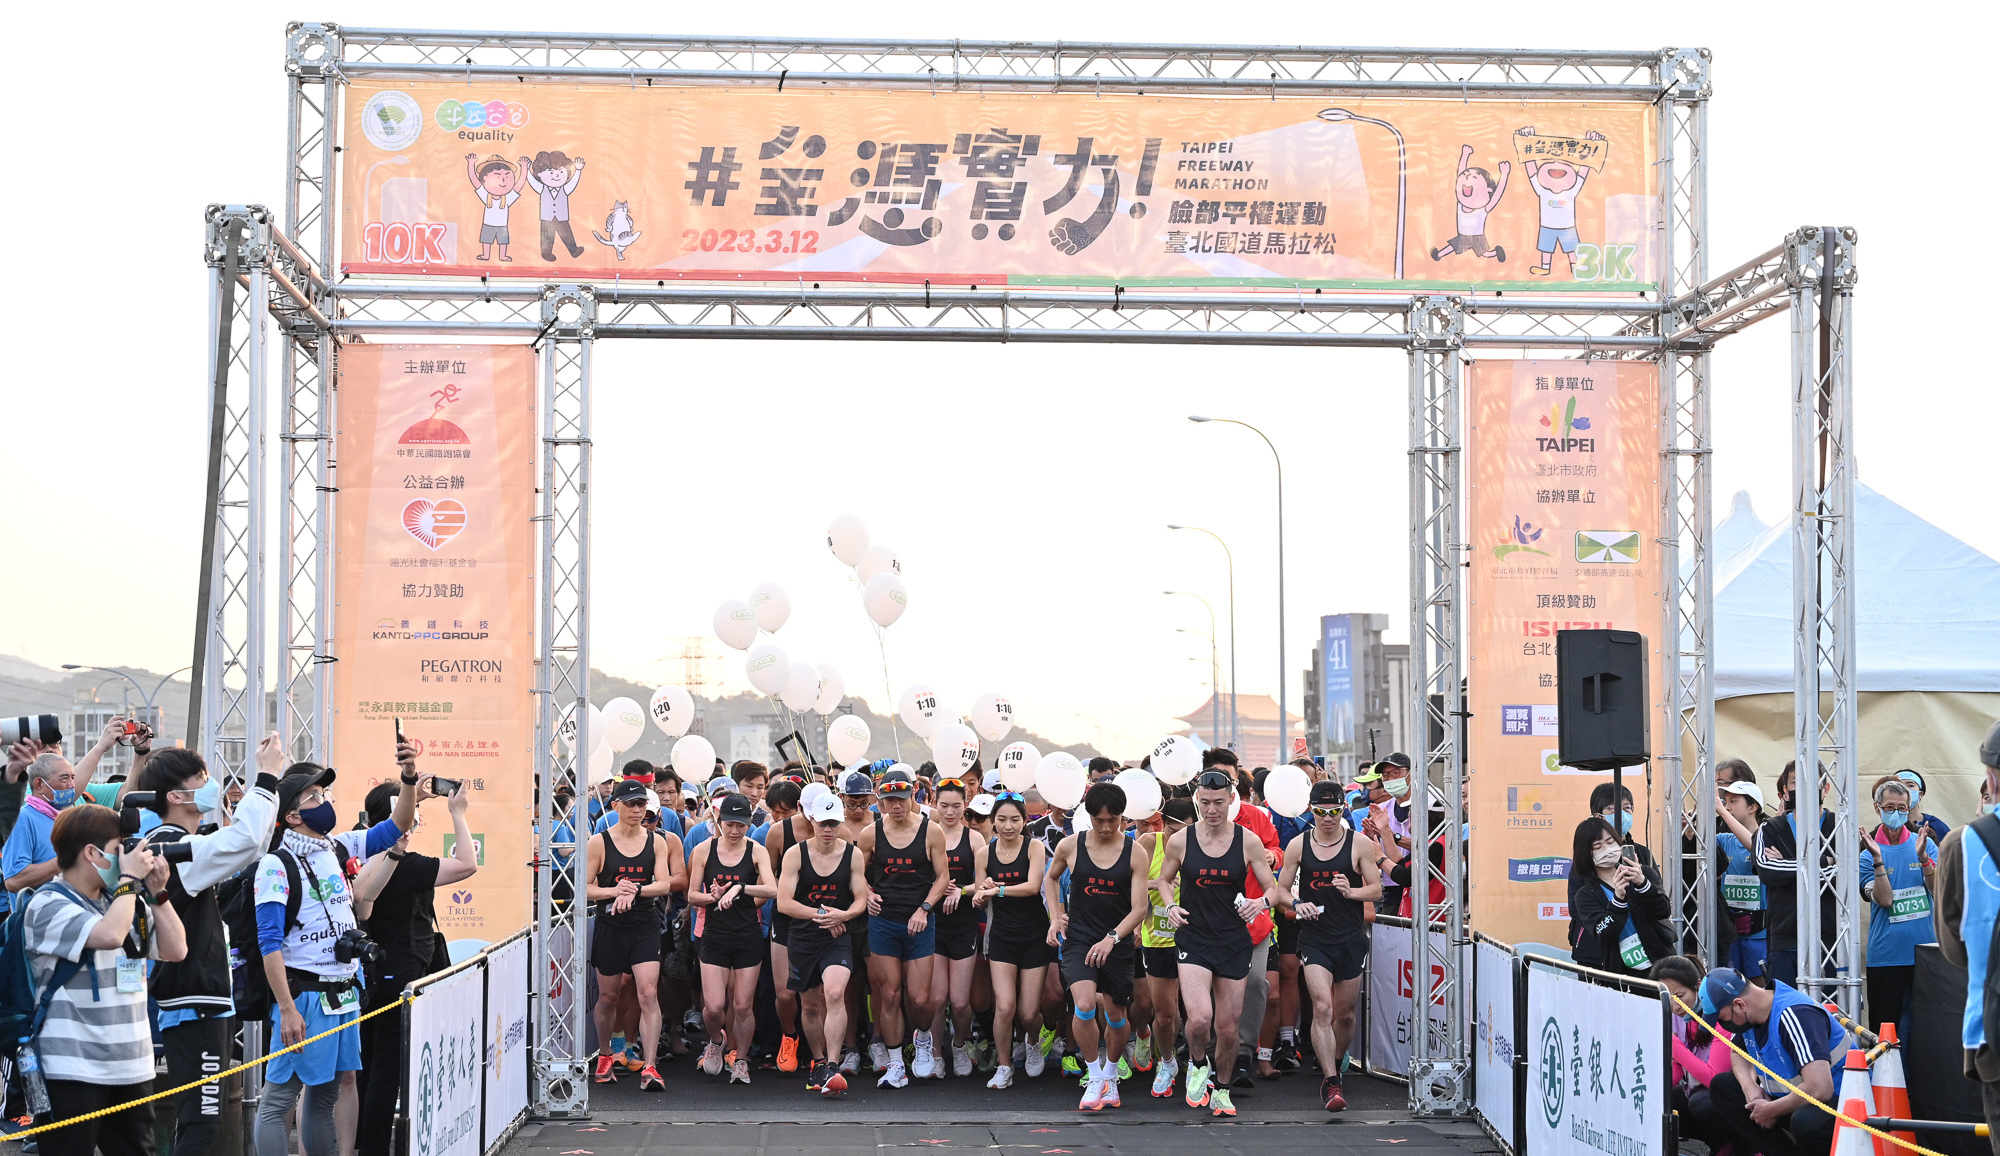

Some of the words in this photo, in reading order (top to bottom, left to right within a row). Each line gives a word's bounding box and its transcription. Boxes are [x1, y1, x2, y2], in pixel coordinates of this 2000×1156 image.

[458, 130, 514, 144] equality
[1181, 142, 1233, 153] TAIPEI
[1177, 160, 1254, 172] FREEWAY
[1174, 178, 1269, 190] MARATHON
[1167, 200, 1327, 226] 臉部平權運動
[364, 222, 447, 264] 10K
[681, 228, 819, 255] 2023.3.12
[1164, 231, 1337, 255] 臺北國道馬拉松
[1574, 243, 1637, 281] 3K
[404, 360, 466, 374] 主辦單位
[1536, 377, 1594, 391] 指導單位
[1536, 438, 1595, 452] TAIPEI
[397, 449, 471, 458] 中華民國路跑協會
[1534, 464, 1597, 477] 臺北市政府
[403, 475, 465, 490] 公益合辦
[1537, 490, 1595, 504] 協辦單位
[390, 558, 476, 568] 陽光社會福利基金會
[402, 584, 464, 598] 協力贊助
[1537, 595, 1596, 609] 頂級贊助
[1328, 638, 1348, 670] 41
[1523, 642, 1558, 656] 台北
[421, 660, 502, 672] PEGATRON
[371, 702, 453, 713] 永真教育基金會
[653, 702, 671, 717] 1:20
[916, 697, 936, 711] 1:10
[996, 703, 1012, 714] 1:10
[1505, 708, 1528, 720] 瀏覽
[1505, 721, 1528, 733] 照片
[429, 741, 500, 749] 華南永昌證券
[1153, 737, 1176, 757] 0:50
[961, 748, 977, 761] 1:10
[1004, 751, 1023, 761] 1:10
[1508, 818, 1553, 827] rhenus
[1517, 864, 1563, 875] 撒隆巴斯
[1726, 888, 1758, 899] 11035
[447, 906, 475, 915] TRUE
[1892, 899, 1926, 914] 10731
[1570, 1024, 1648, 1125] 臺銀人壽
